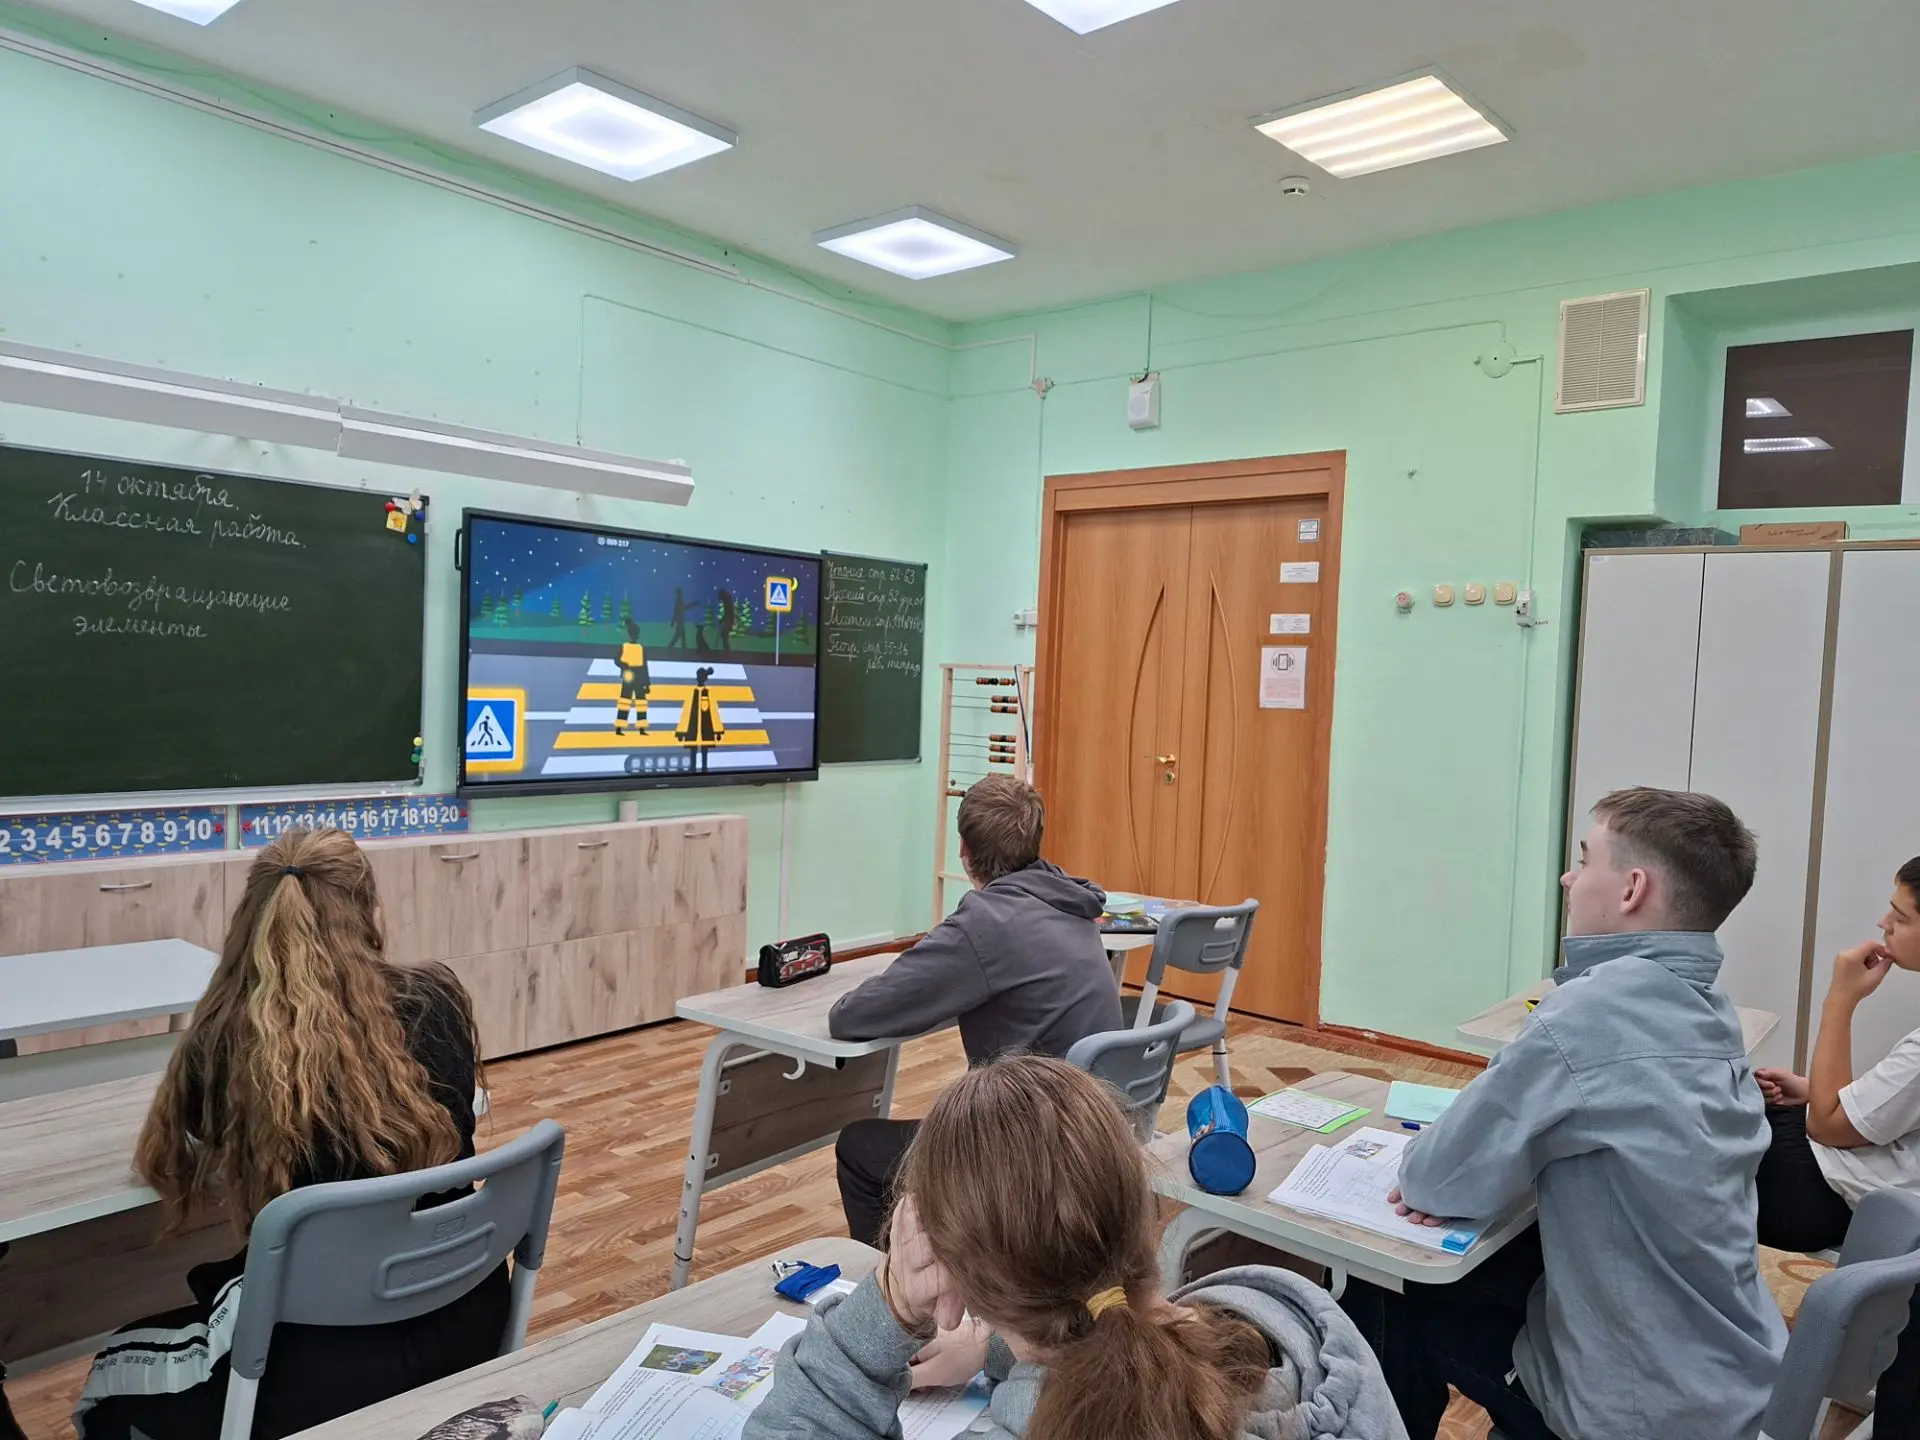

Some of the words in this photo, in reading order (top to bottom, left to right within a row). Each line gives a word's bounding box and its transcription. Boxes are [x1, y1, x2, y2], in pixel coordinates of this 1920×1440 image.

[80, 469, 107, 494] 14
[48, 492, 201, 535] Классная
[21, 828, 36, 850] 3
[45, 827, 62, 849] 4
[71, 825, 86, 848] 5
[95, 824, 111, 846] 6
[118, 823, 133, 845] 7
[140, 821, 155, 843] 8
[163, 820, 178, 842] 9
[185, 818, 211, 840] 10
[251, 816, 269, 835] 11
[272, 815, 292, 832] 12
[339, 811, 358, 829] 15
[360, 809, 379, 828] 16
[381, 808, 399, 827] 17
[401, 807, 419, 825] 18
[421, 806, 438, 824] 19
[440, 805, 459, 823] 20
